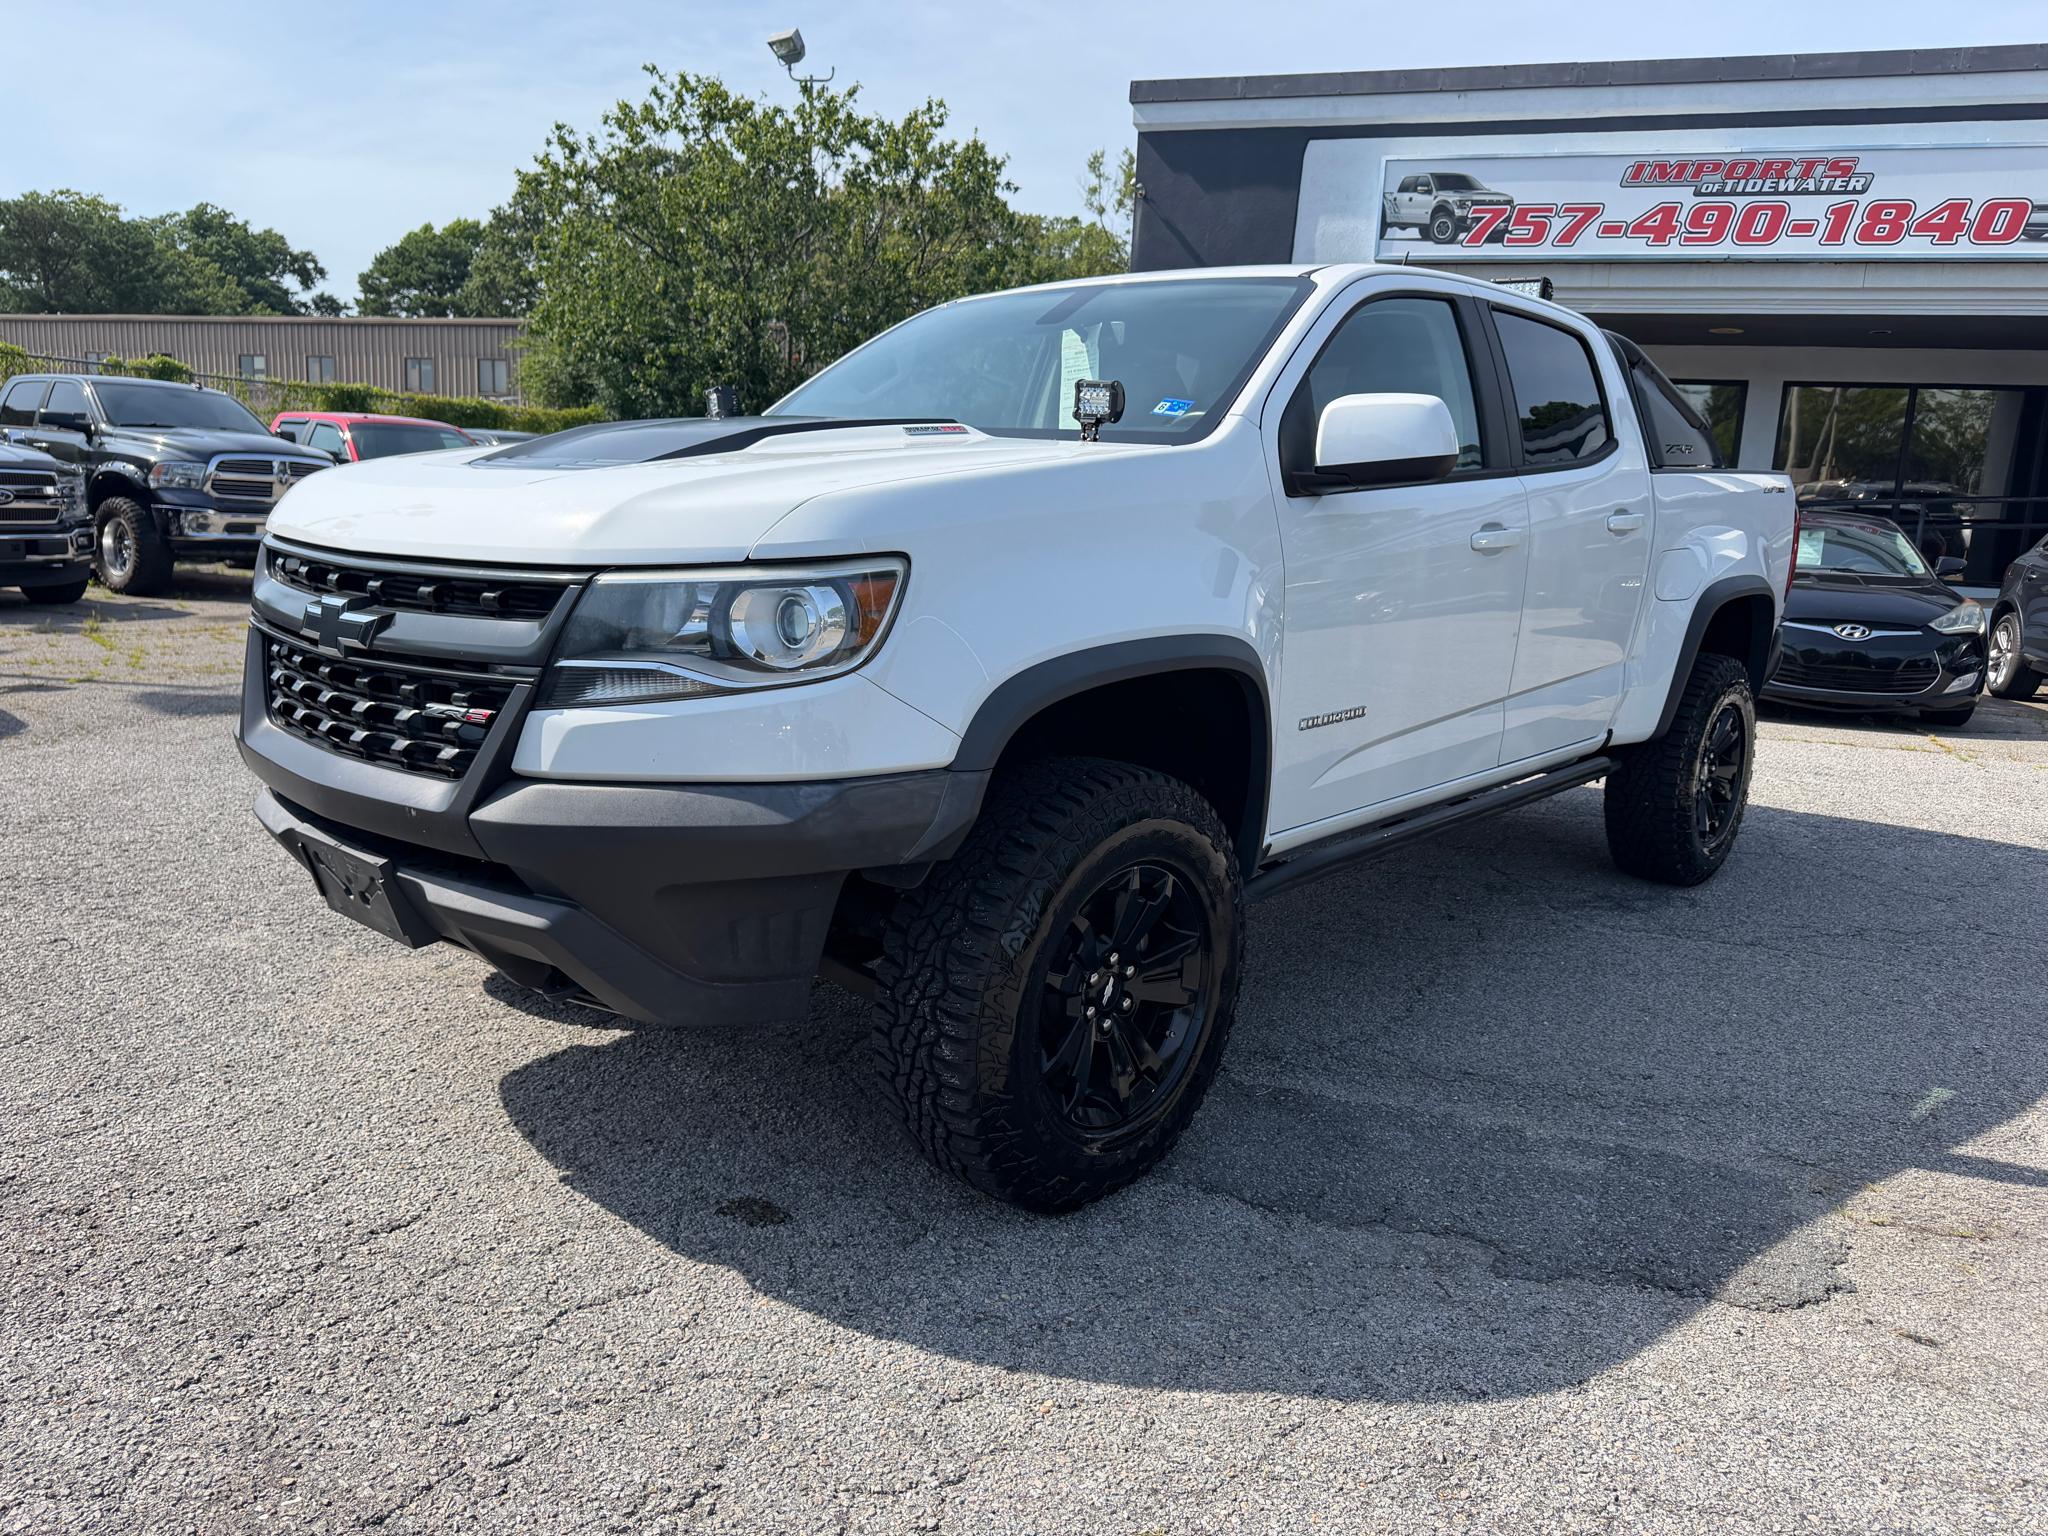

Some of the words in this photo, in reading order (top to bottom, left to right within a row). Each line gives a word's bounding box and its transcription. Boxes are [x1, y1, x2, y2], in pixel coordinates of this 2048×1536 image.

[1626, 156, 1859, 183] IMPORTS
[1723, 175, 1868, 193] TIDEWATER
[1461, 198, 2034, 247] 757-490-1840
[422, 702, 497, 725] ZR2
